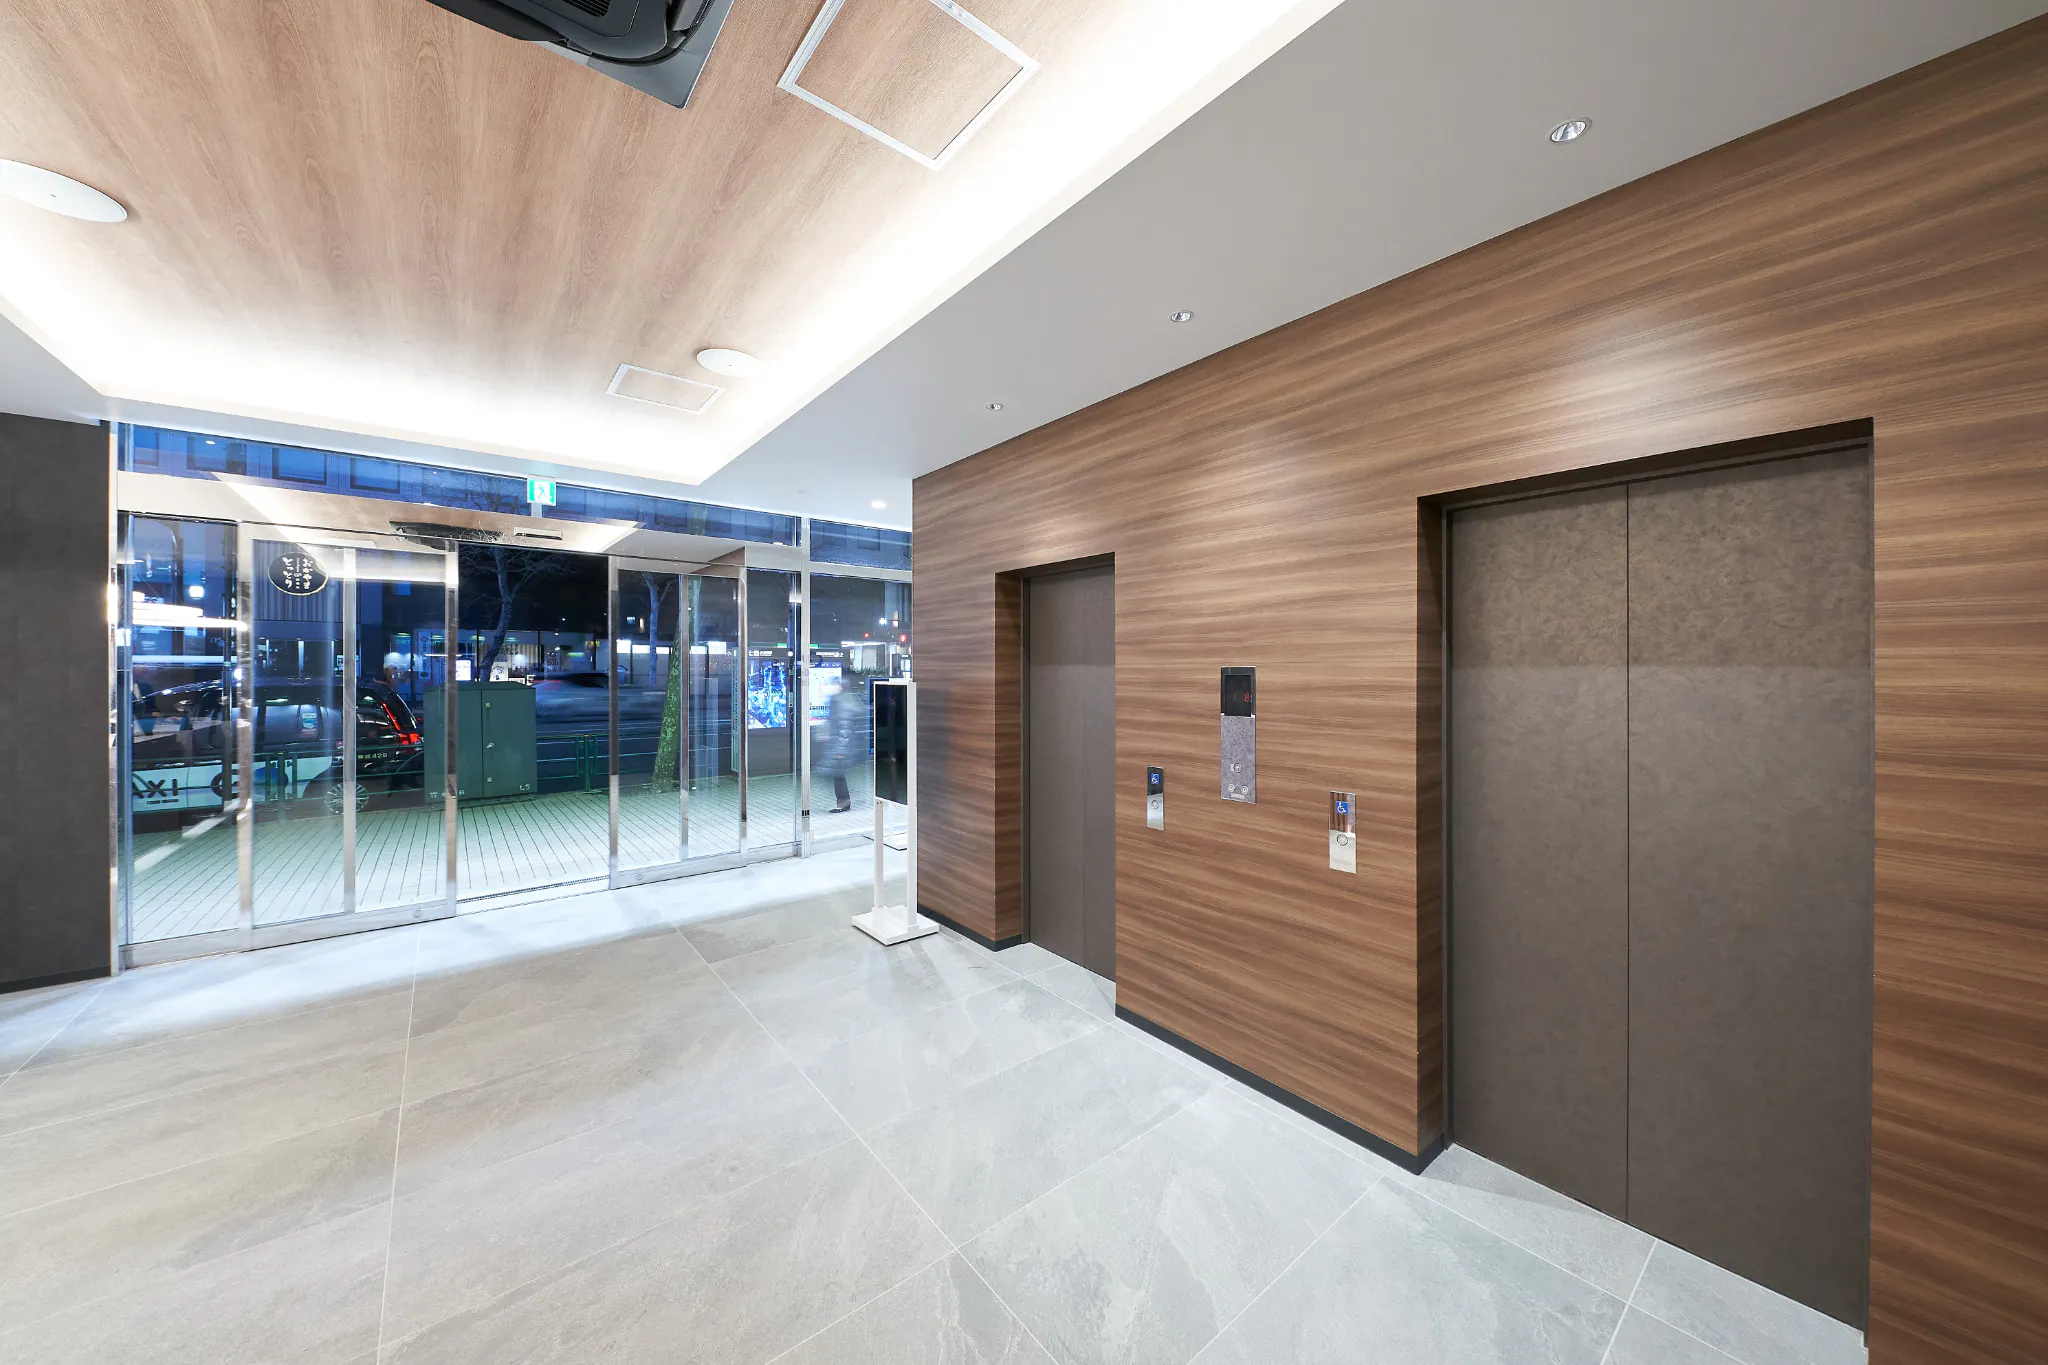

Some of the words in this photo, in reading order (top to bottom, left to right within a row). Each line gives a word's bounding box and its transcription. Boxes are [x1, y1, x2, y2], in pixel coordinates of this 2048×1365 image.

[282, 557, 294, 589] とっとり
[302, 558, 313, 589] おかやま
[132, 779, 179, 799] AXI
